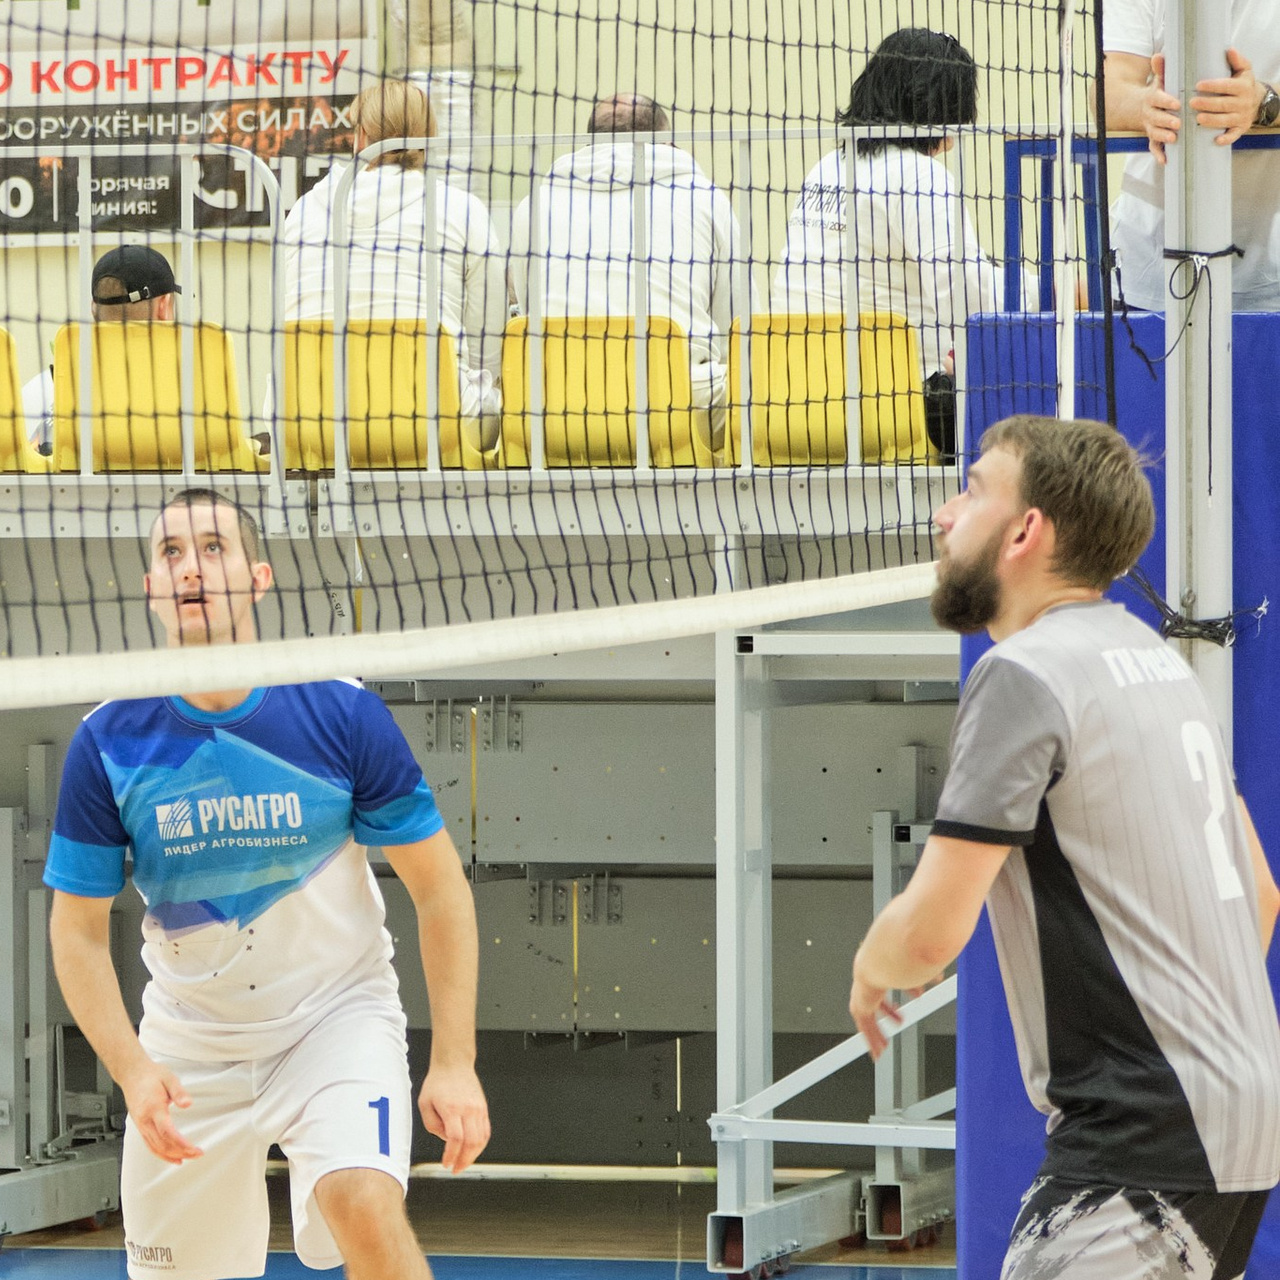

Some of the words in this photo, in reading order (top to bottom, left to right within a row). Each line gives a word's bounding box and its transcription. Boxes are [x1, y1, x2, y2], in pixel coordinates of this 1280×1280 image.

[29, 48, 350, 95] КОНТРАКТУ
[236, 107, 353, 134] СИЛАХ
[77, 174, 170, 197] орячая
[75, 201, 158, 218] иния:
[197, 792, 303, 835] РУСАГРО
[164, 841, 207, 857] ЛИДЕР
[211, 835, 309, 849] АГРОБИЗНЕСА
[368, 1096, 390, 1157] 1
